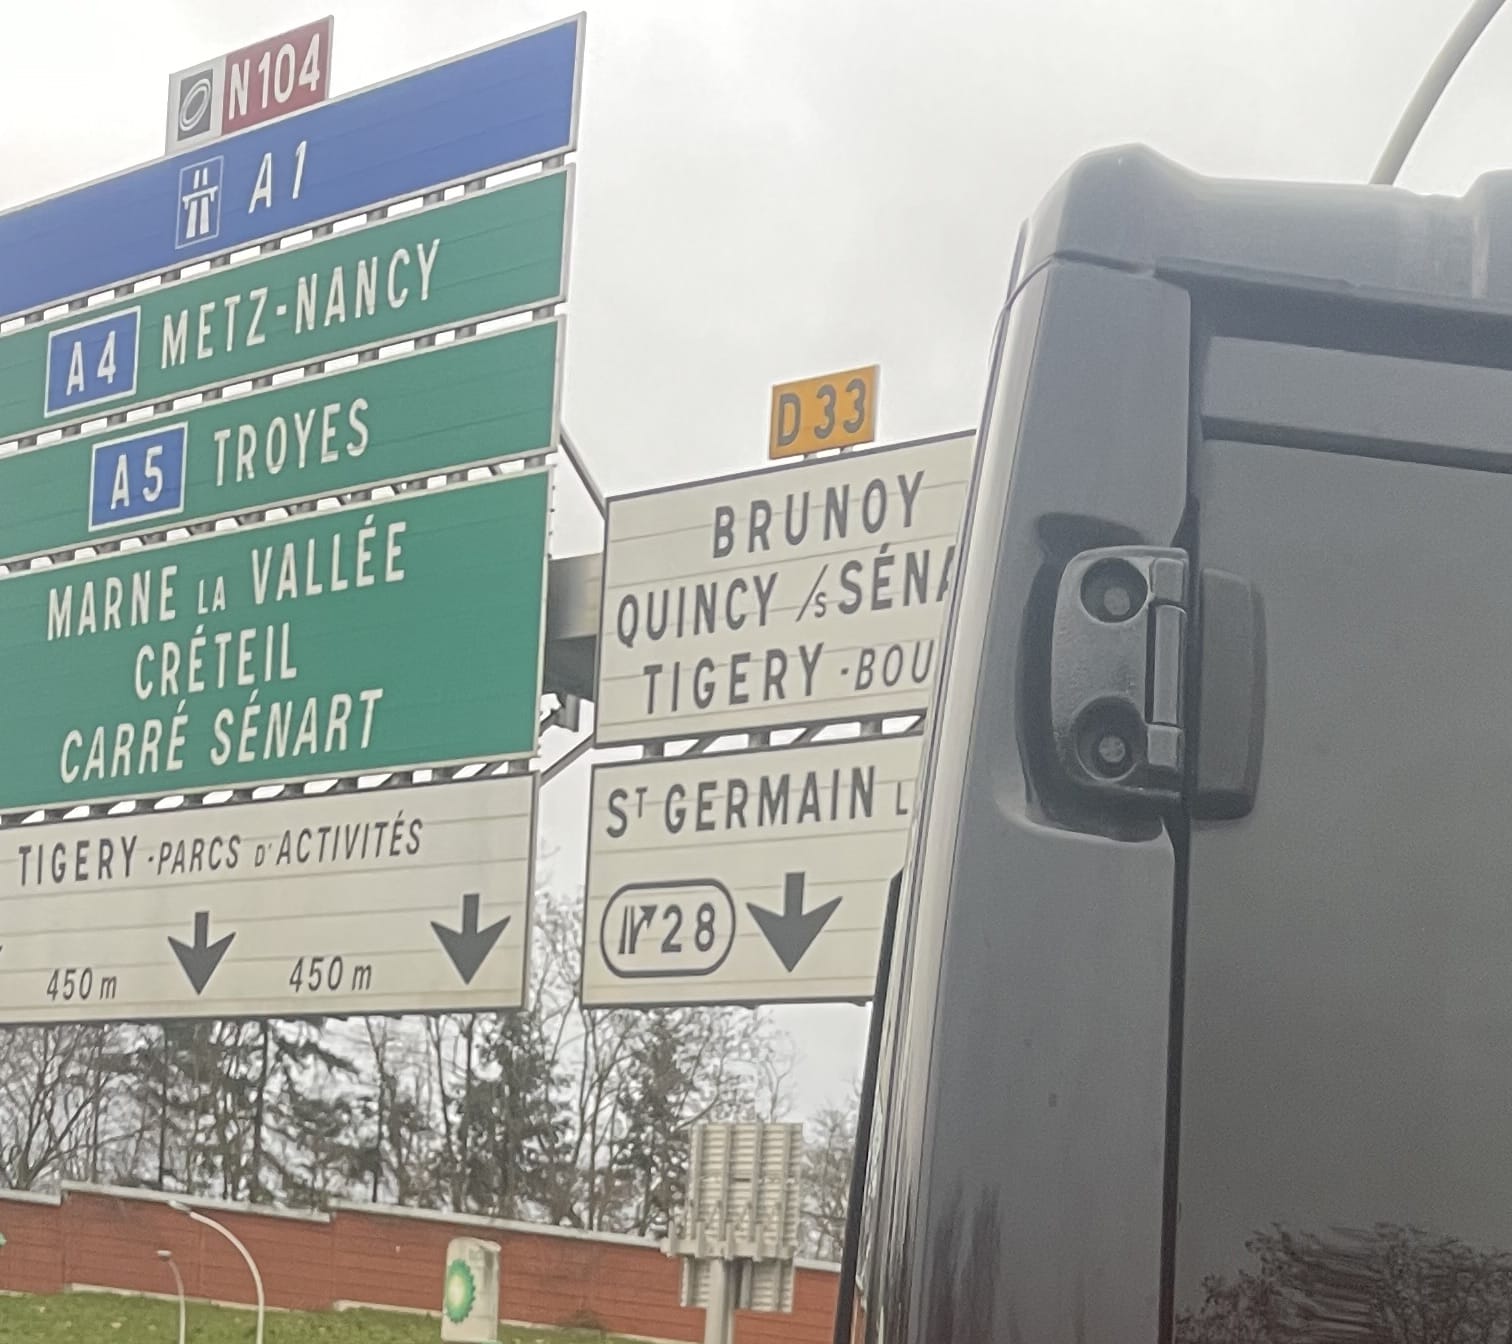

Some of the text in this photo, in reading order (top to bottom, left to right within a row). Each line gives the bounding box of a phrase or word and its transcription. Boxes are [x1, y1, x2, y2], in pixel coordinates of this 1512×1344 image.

[228, 33, 321, 120] N104
[161, 238, 441, 369] METZ-NANCY
[214, 397, 370, 486] TROYES
[712, 470, 925, 559] BRUNOY
[47, 514, 407, 641] MARNE LA VALLÉE
[616, 571, 779, 649] QUINCY
[135, 622, 298, 700] CRÉTEIL
[643, 642, 824, 715] TIGERY
[60, 688, 384, 784] CARRÉ SÉNART
[664, 765, 875, 834] GERMAIN
[661, 902, 715, 953] 28
[46, 967, 93, 1001] 450
[289, 955, 344, 992] 450
